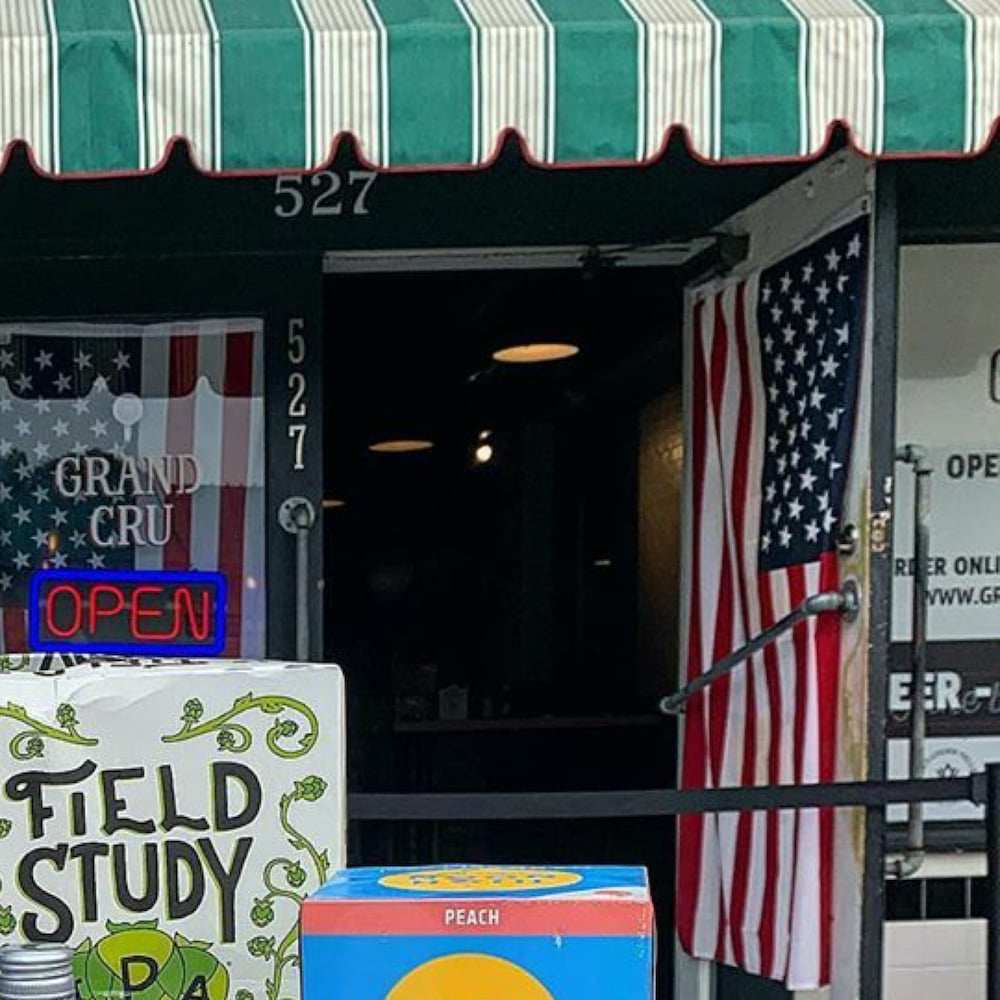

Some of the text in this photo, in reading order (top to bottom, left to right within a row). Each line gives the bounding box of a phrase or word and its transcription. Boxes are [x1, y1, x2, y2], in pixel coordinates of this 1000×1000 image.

[274, 171, 378, 218] 527
[288, 318, 307, 470] 527
[55, 454, 201, 498] GRAND
[947, 453, 1000, 479] OPE
[90, 504, 175, 546] CRU
[46, 585, 210, 641] OPEN
[4, 760, 263, 840] FIELD
[17, 836, 254, 944] STUDY
[444, 908, 500, 927] PEACH
